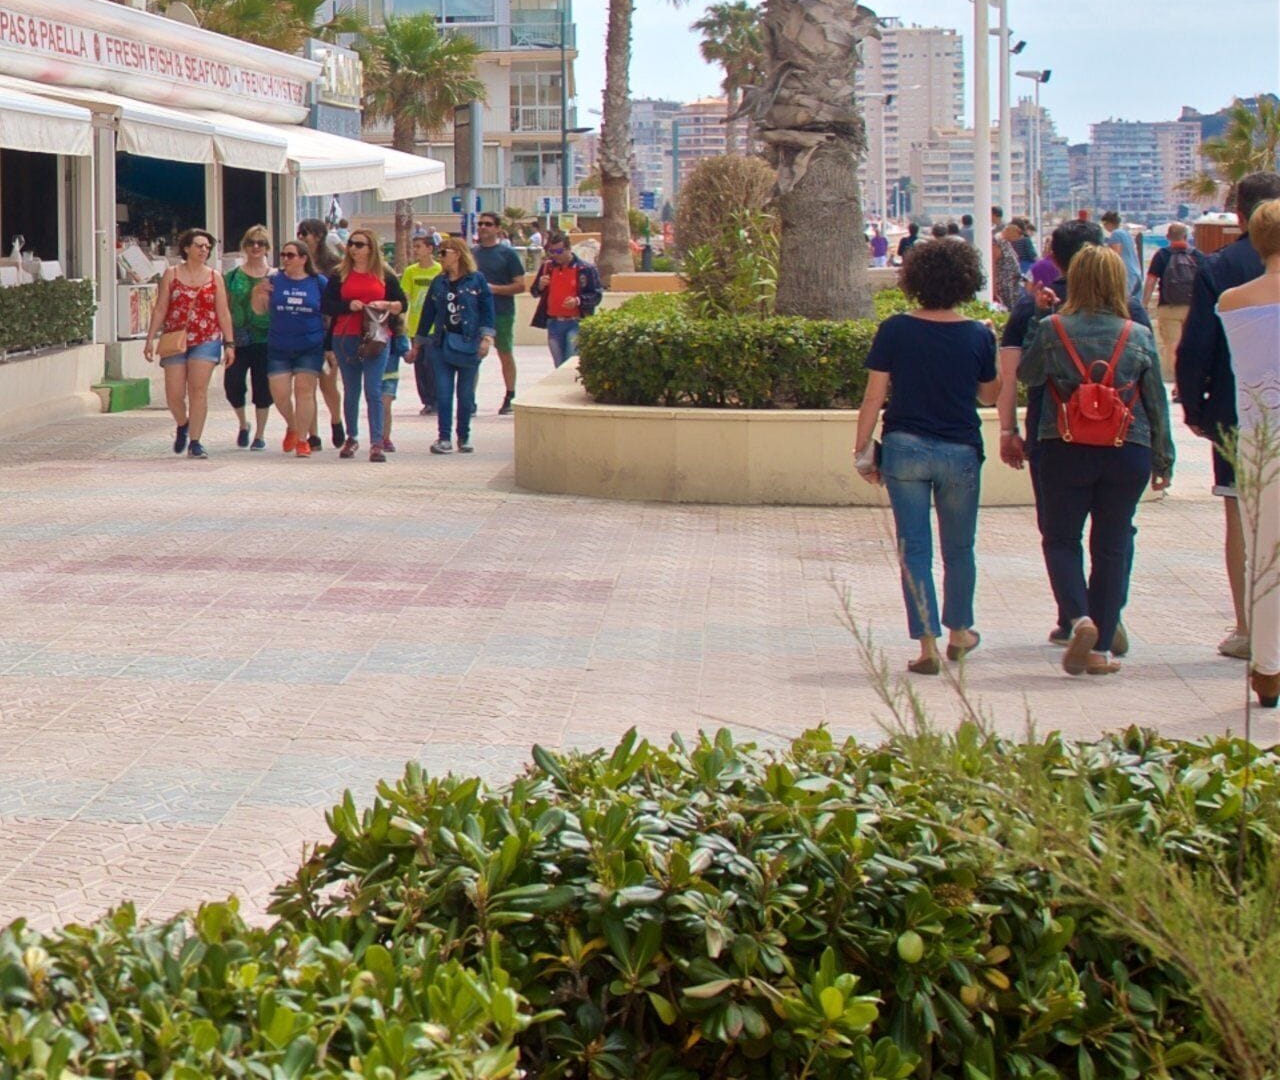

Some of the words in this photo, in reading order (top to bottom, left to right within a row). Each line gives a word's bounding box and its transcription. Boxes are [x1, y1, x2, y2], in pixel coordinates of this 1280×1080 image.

[28, 19, 38, 47] &
[40, 21, 88, 58] PAELLA
[106, 37, 146, 70] FRESH
[149, 48, 176, 76] FISH
[176, 54, 184, 76] &
[185, 56, 231, 88] SEAFOOD
[241, 71, 273, 97] FRENCH
